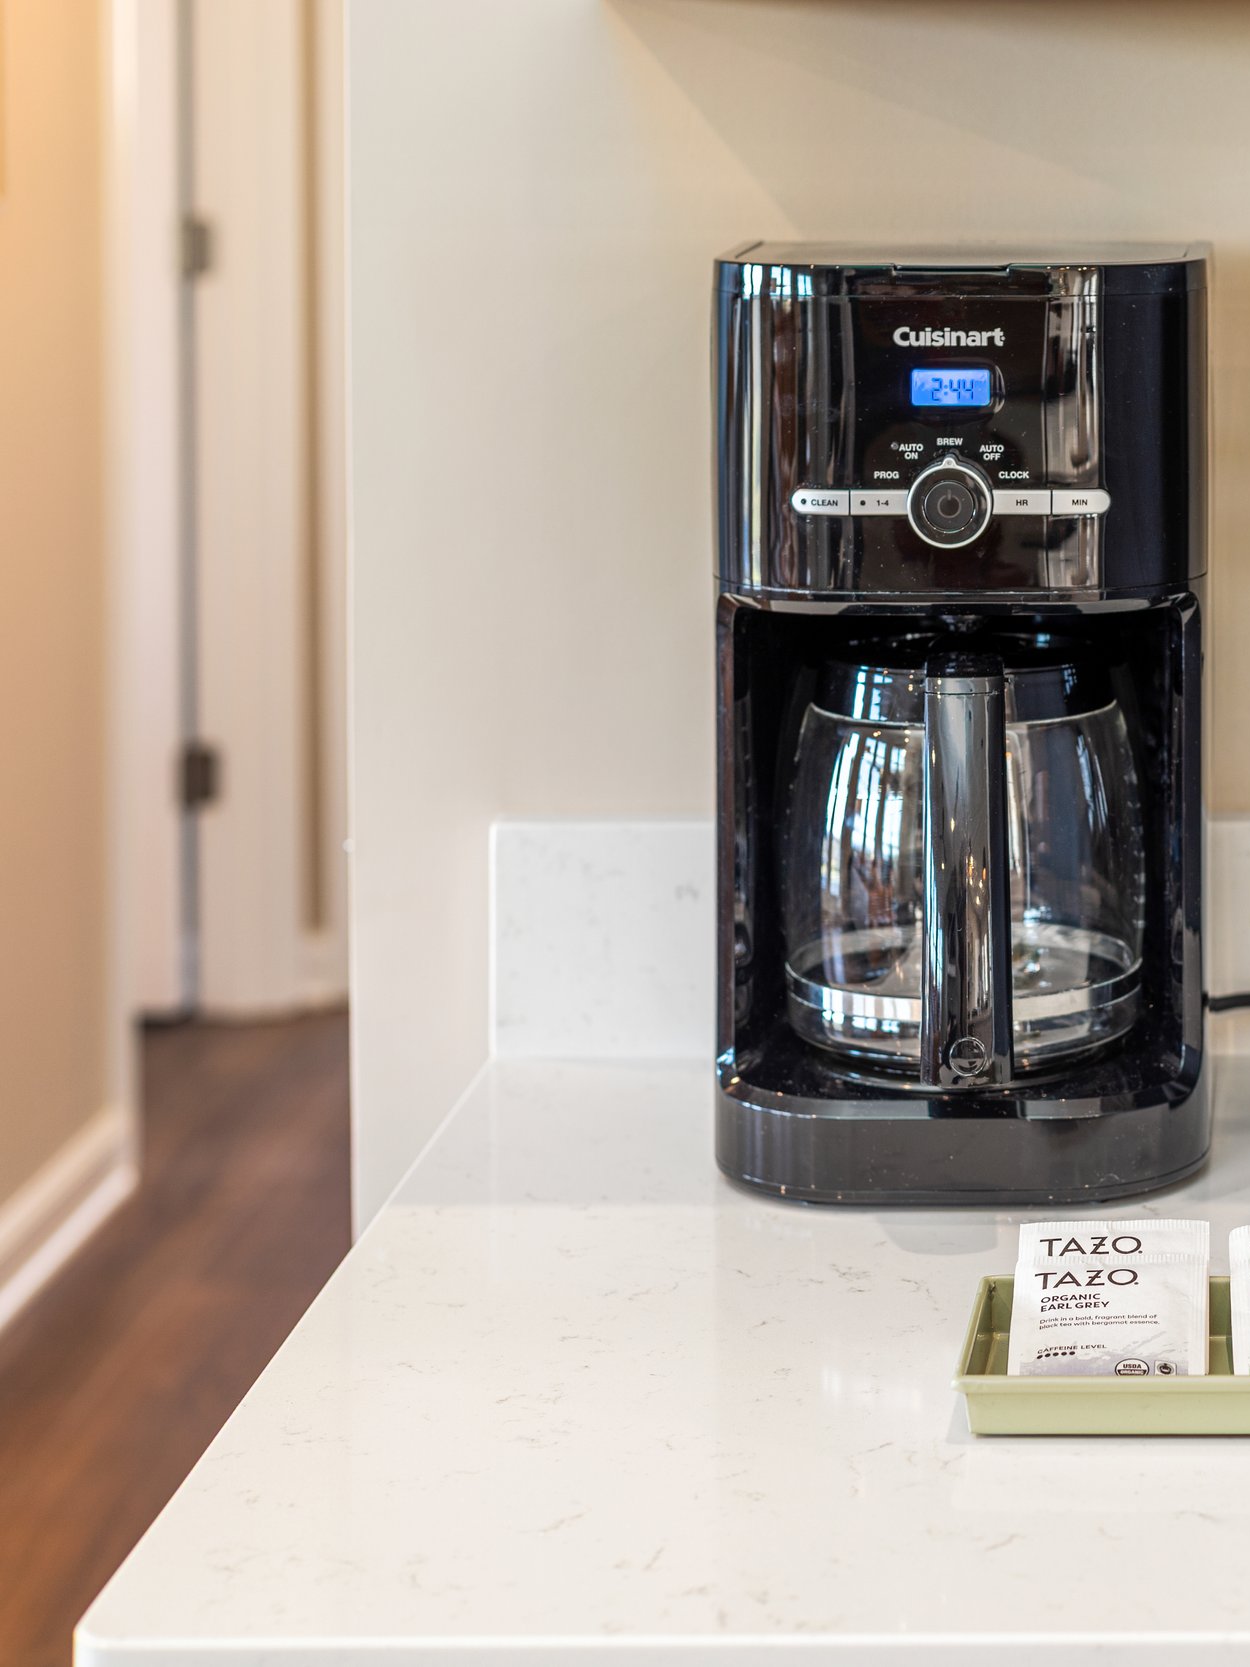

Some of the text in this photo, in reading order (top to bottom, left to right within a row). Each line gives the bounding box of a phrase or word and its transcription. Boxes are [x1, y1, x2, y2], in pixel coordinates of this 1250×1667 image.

[893, 326, 1004, 347] Cuisinart
[931, 377, 974, 401] 2:44
[936, 437, 963, 446] BREW
[899, 443, 923, 452] AUTO
[979, 444, 1004, 453] AUTO
[904, 452, 918, 460] ON
[983, 452, 1001, 461] OFF
[874, 471, 899, 479] PROG
[998, 471, 1029, 479] CLOCK
[811, 499, 838, 507] CLEAN
[1040, 1235, 1142, 1257] TAZO
[1035, 1268, 1138, 1290] TAZO
[1040, 1293, 1101, 1303] ORGANIC
[1040, 1301, 1110, 1313] EARL GREY
[1039, 1316, 1060, 1325] Drink
[1039, 1322, 1058, 1330] black
[1037, 1344, 1078, 1355] CAFFEINE
